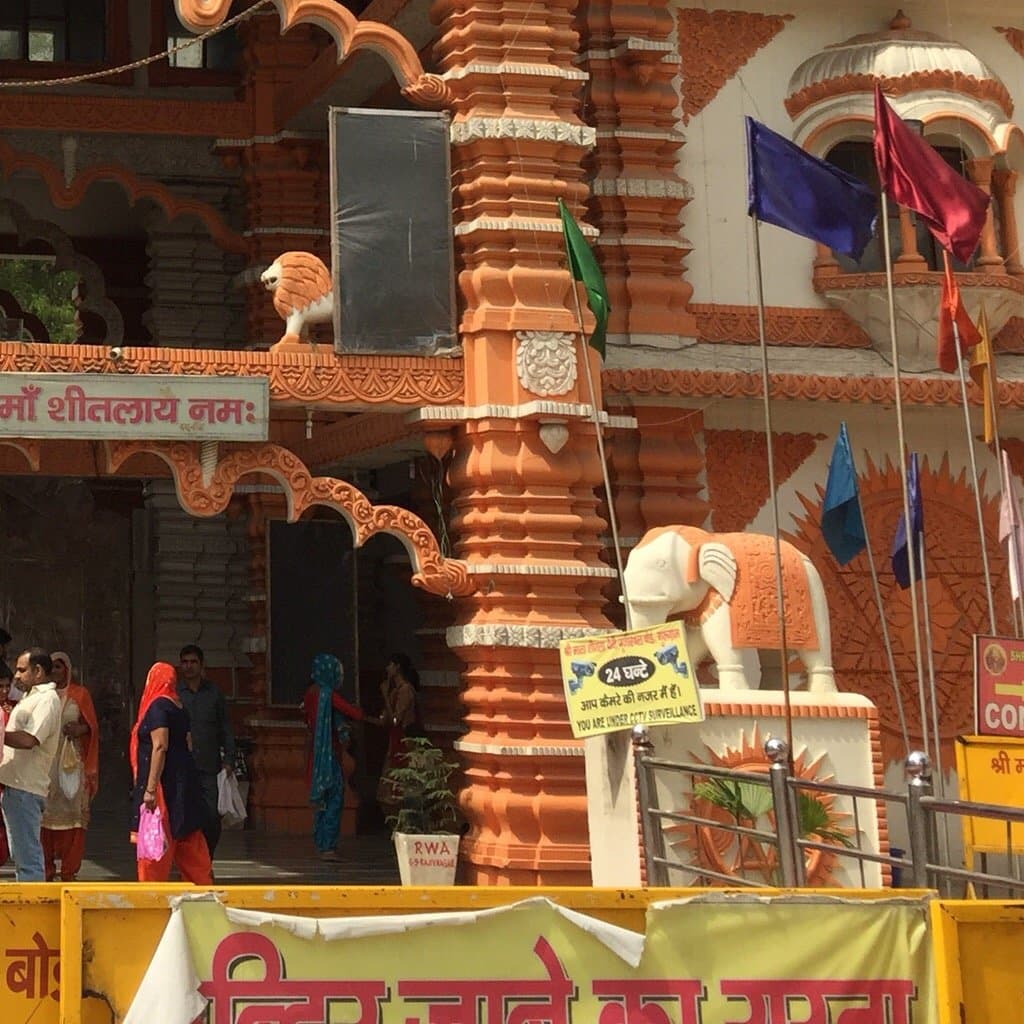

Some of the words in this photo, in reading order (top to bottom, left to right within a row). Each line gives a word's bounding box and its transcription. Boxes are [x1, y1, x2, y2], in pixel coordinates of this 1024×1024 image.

[47, 385, 180, 424] शीतलाय
[605, 667, 621, 683] 24
[580, 699, 598, 712] आप
[623, 689, 636, 704] की
[637, 690, 659, 703] नजर
[576, 719, 591, 732] YOU
[592, 717, 606, 729] ARE
[606, 713, 629, 727] UNDER
[630, 711, 648, 725] CCTV
[648, 704, 698, 720] SURVEILLANCE
[991, 750, 1010, 775] श्री
[415, 841, 450, 855] RWA
